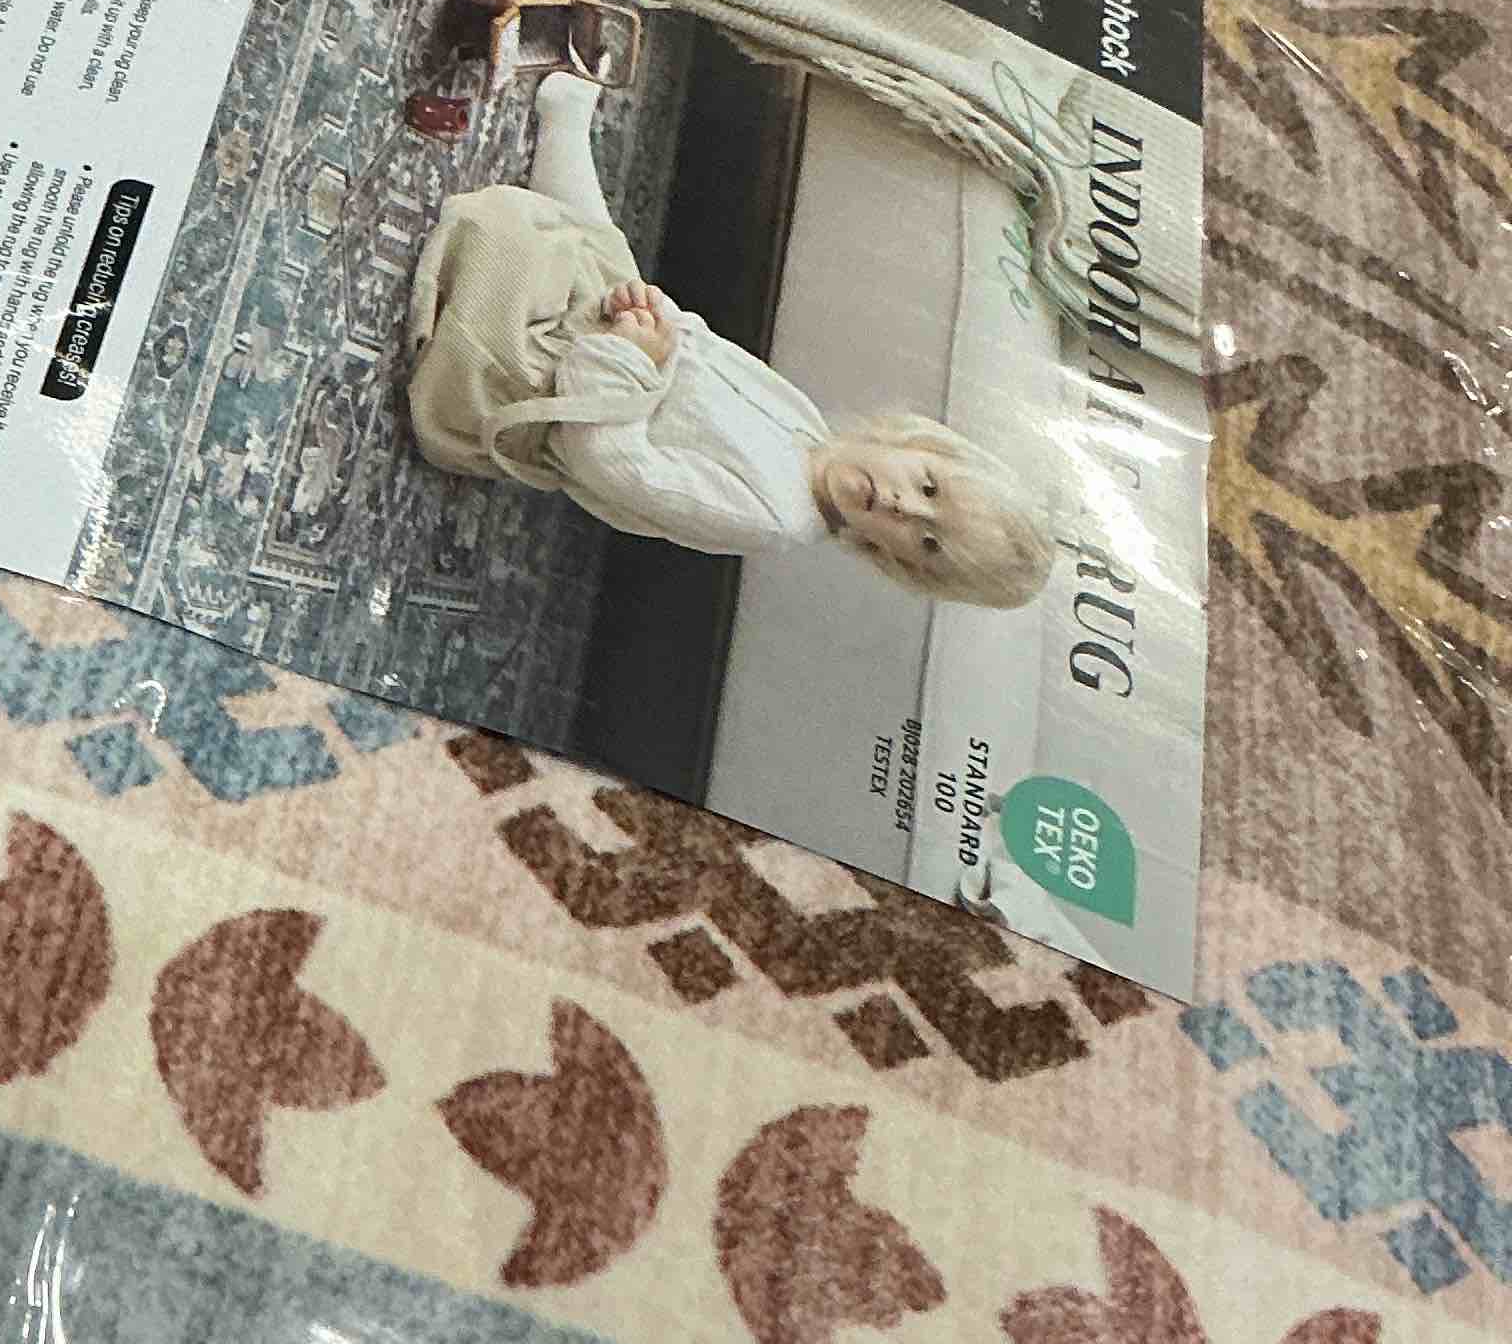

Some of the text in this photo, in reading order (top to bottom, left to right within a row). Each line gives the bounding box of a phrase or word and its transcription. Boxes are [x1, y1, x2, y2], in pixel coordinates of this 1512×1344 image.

[95, 21, 118, 51] with
[120, 19, 144, 51] your
[27, 51, 49, 76] not
[113, 46, 135, 71] rug
[18, 72, 39, 98] use
[104, 68, 131, 108] clean.
[9, 157, 49, 216] allowing
[39, 166, 70, 216] smooth
[65, 173, 94, 218] Please
[5, 210, 29, 237] the
[31, 213, 54, 238] the
[50, 214, 80, 259] unfold
[1082, 115, 1150, 353] INDOOR
[18, 233, 42, 260] rug
[42, 255, 65, 281] the
[54, 187, 141, 389] Tips on reducing creases!
[29, 276, 53, 303] rug
[5, 338, 31, 369] you
[1068, 538, 1139, 706] RUG
[868, 732, 892, 799] TESTEX
[893, 764, 918, 835] 202654
[932, 767, 957, 816] 100
[957, 733, 989, 871] STANDARD
[1066, 803, 1100, 895] OEKO
